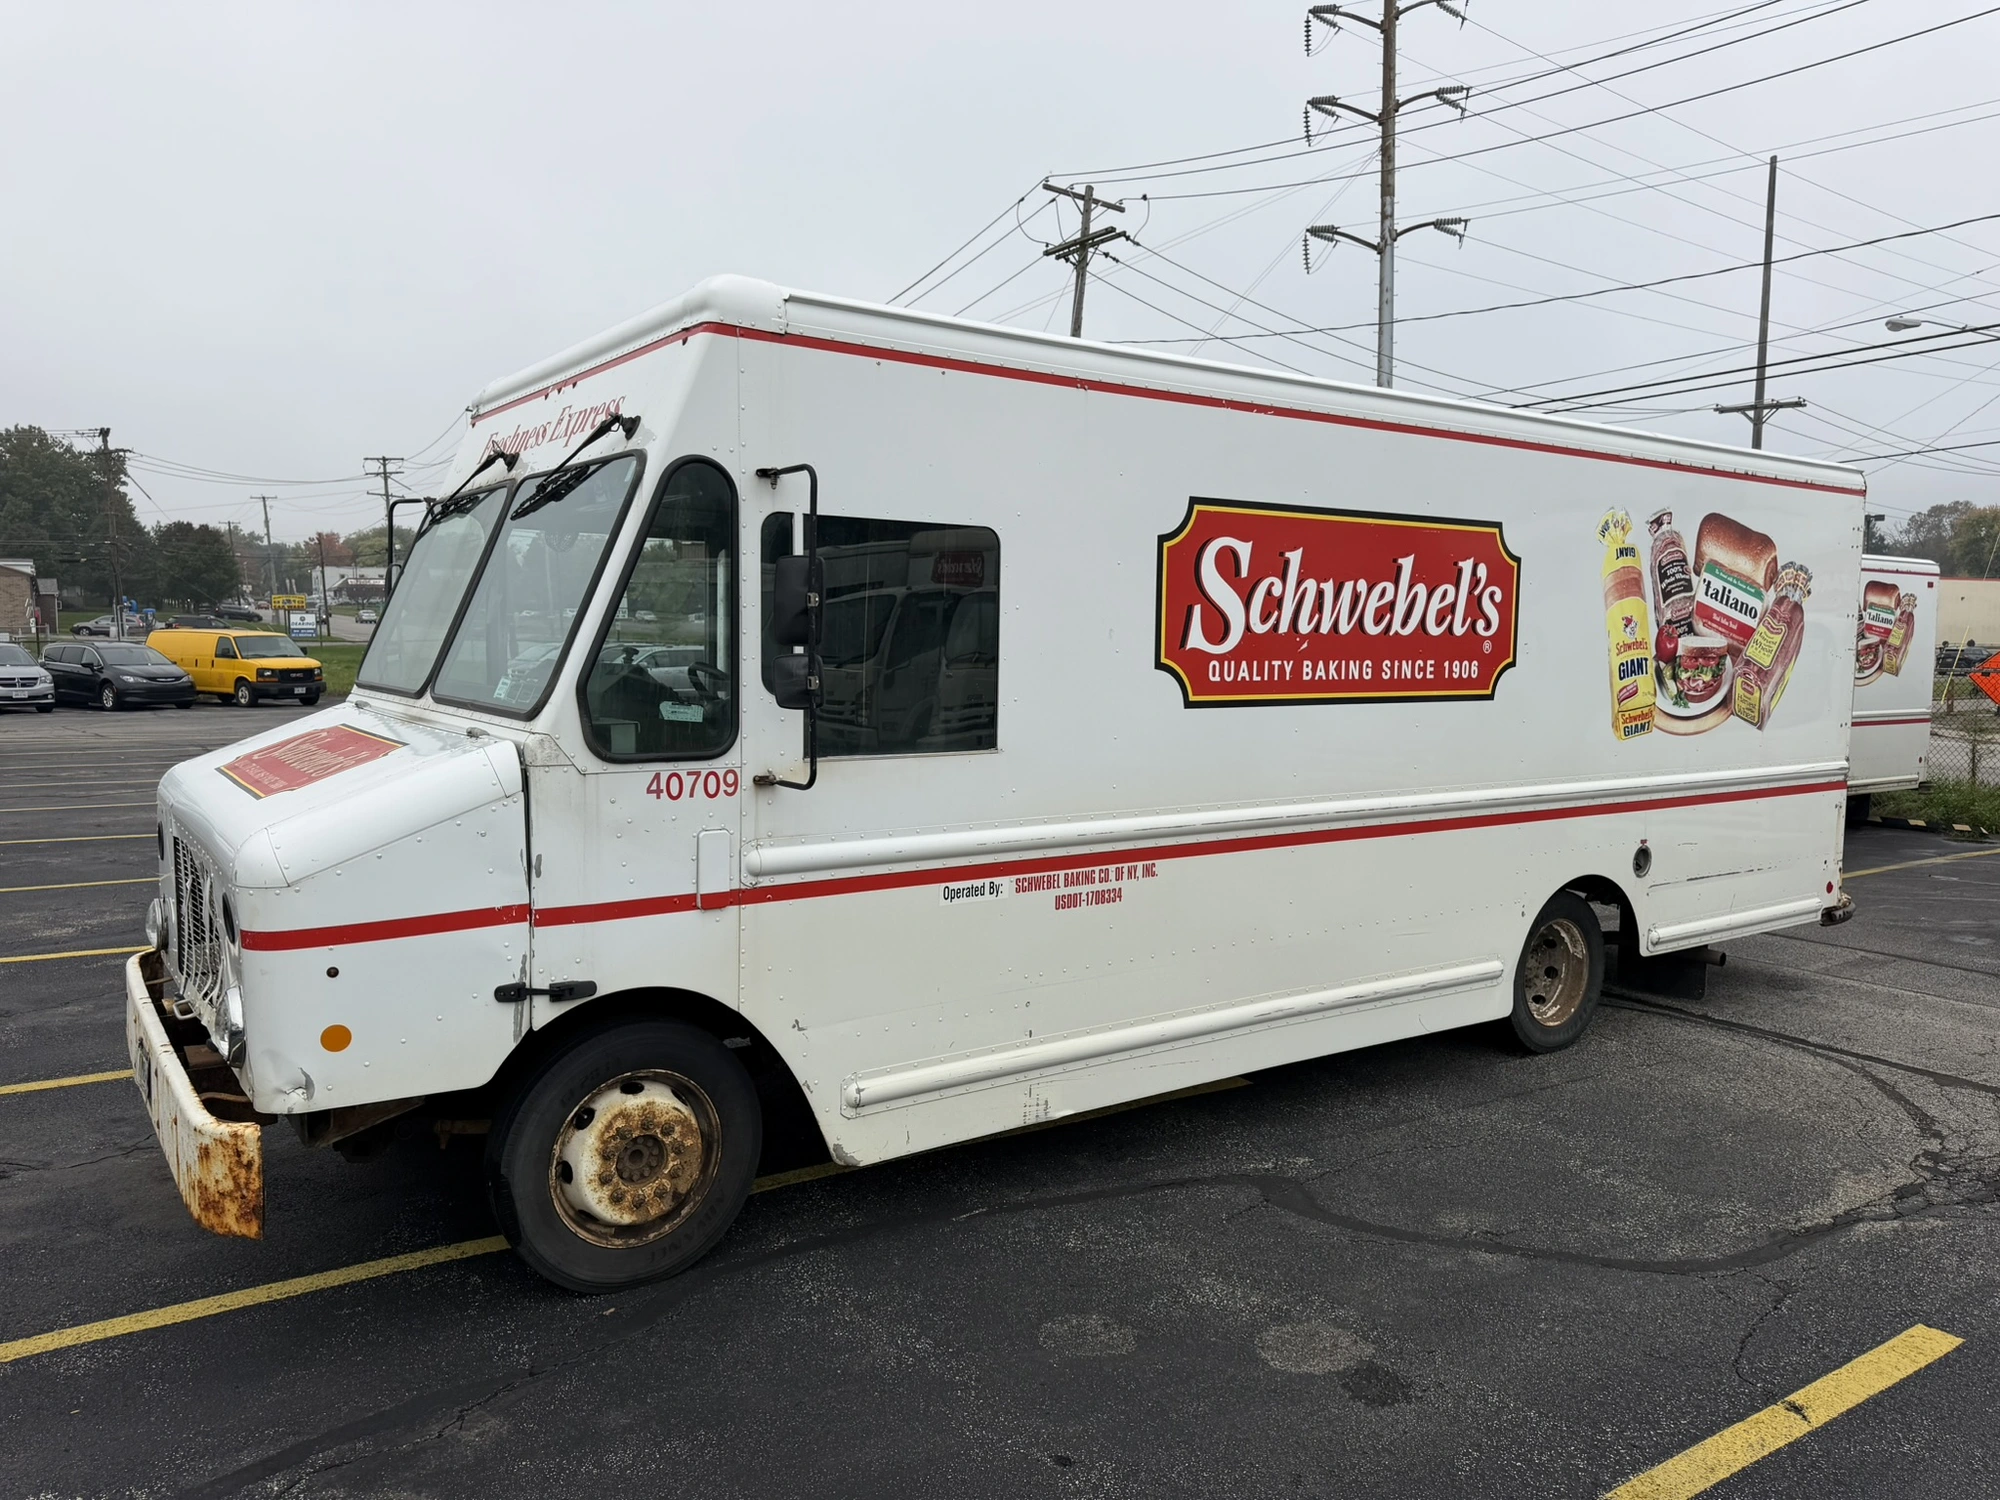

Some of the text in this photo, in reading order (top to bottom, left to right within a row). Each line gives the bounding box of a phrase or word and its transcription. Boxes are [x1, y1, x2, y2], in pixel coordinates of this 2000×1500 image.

[547, 395, 627, 448] Express
[1615, 546, 1636, 561] GIANT
[1182, 536, 1502, 655] Schwebel's
[1615, 637, 1649, 657] Schwebel's
[1208, 659, 1479, 682] QUALITY BAKING SINCE 1906
[1618, 656, 1649, 681] GIANT
[1620, 709, 1653, 725] Schwebel's
[1623, 721, 1651, 737] GIANT
[645, 768, 739, 801] 40709
[942, 862, 1159, 903] Operated By: SCHWEBEL BAKING CO. OF NY, INC.
[1054, 887, 1123, 911] USDOT-1708334
